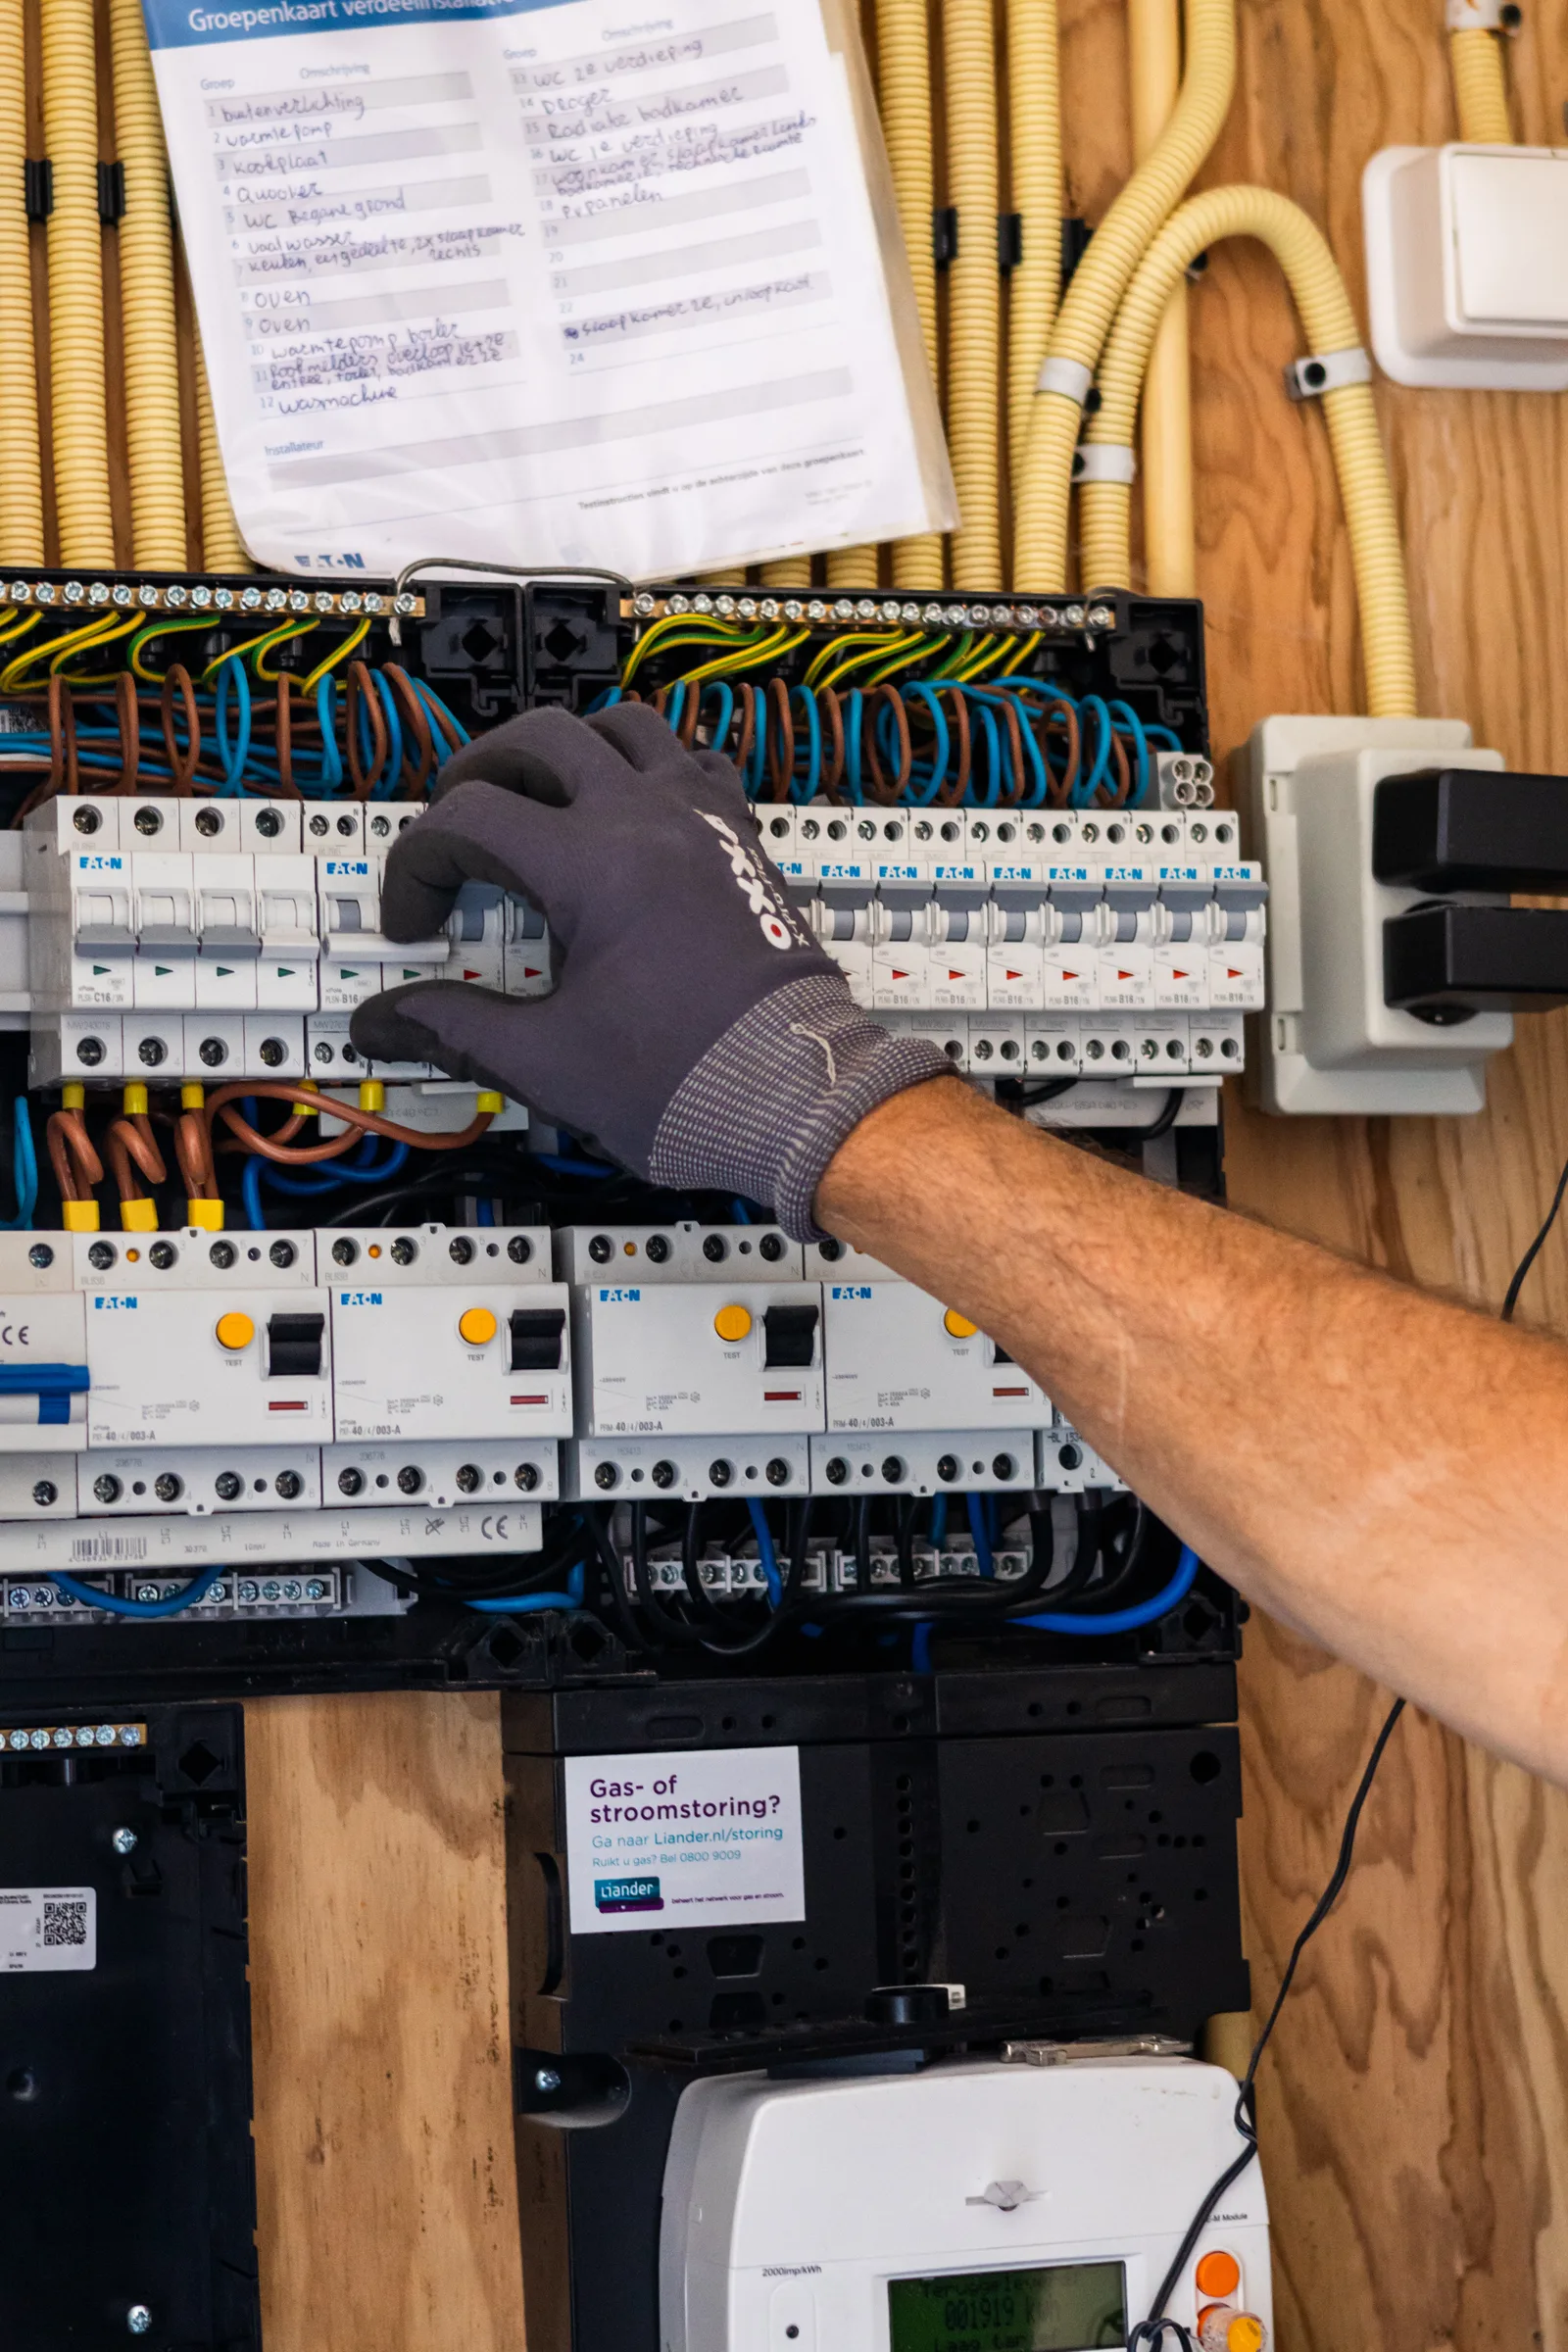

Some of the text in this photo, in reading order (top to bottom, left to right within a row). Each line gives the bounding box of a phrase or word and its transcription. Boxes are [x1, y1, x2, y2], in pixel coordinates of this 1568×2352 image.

[188, 0, 337, 32] Groepenkaart
[200, 78, 235, 90] Groep
[265, 439, 324, 457] Installateur
[79, 857, 122, 870] EATON
[326, 861, 368, 875] EATON
[777, 862, 802, 874] TON
[821, 865, 860, 877] EATON
[879, 866, 917, 878] EATON
[936, 866, 974, 879] EATON
[994, 867, 1031, 879] EATON
[1050, 867, 1087, 880] EATON
[1105, 867, 1143, 880] EATON
[1160, 867, 1197, 879] EATON
[1214, 867, 1250, 879] EATON
[600, 1290, 640, 1301] EATON
[832, 1287, 872, 1299] EATON
[95, 1297, 137, 1309] EATON
[341, 1294, 382, 1305] EATON
[590, 1775, 677, 1798] Gas- of
[590, 1794, 781, 1824] stroomstoring?
[592, 1827, 783, 1848] Ga naar Liander.nl/storing
[593, 1856, 620, 1867] Ruikt
[633, 1854, 658, 1867] gas?
[660, 1853, 677, 1864] Bel
[679, 1851, 710, 1863] 0800
[712, 1850, 742, 1861] 9009
[601, 1882, 654, 1898] Liander
[1223, 2213, 1248, 2222] Module
[762, 2265, 822, 2277] 2000imp/kWh
